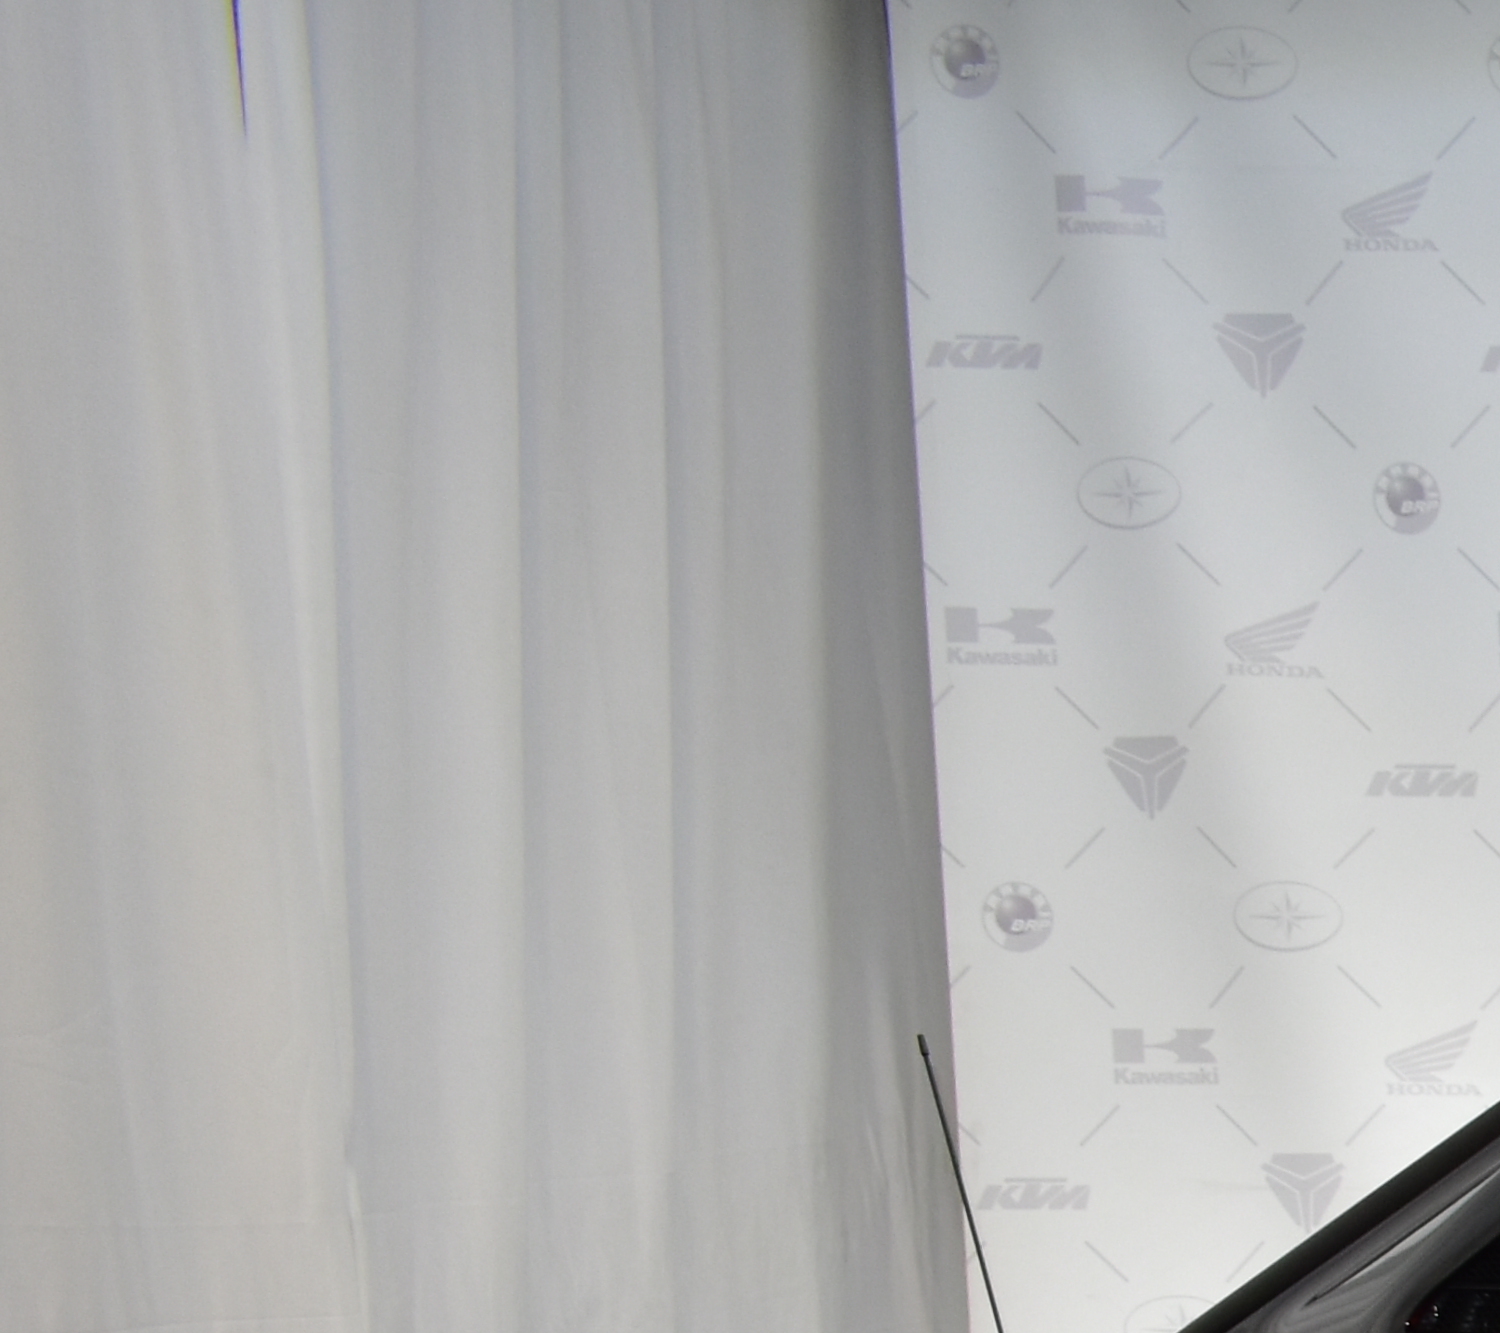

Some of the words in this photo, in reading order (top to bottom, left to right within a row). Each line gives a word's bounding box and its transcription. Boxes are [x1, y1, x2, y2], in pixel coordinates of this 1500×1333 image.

[1057, 216, 1166, 239] Kawasaki
[1343, 237, 1438, 252] HONDA
[926, 335, 1043, 369] KTM
[947, 648, 1058, 666] Kawasaki
[1226, 663, 1324, 679] HONDA
[1366, 764, 1479, 798] KTM
[1114, 1068, 1219, 1085] Kawasaki
[1386, 1082, 1483, 1097] HONDA
[979, 1177, 1090, 1211] KTM
